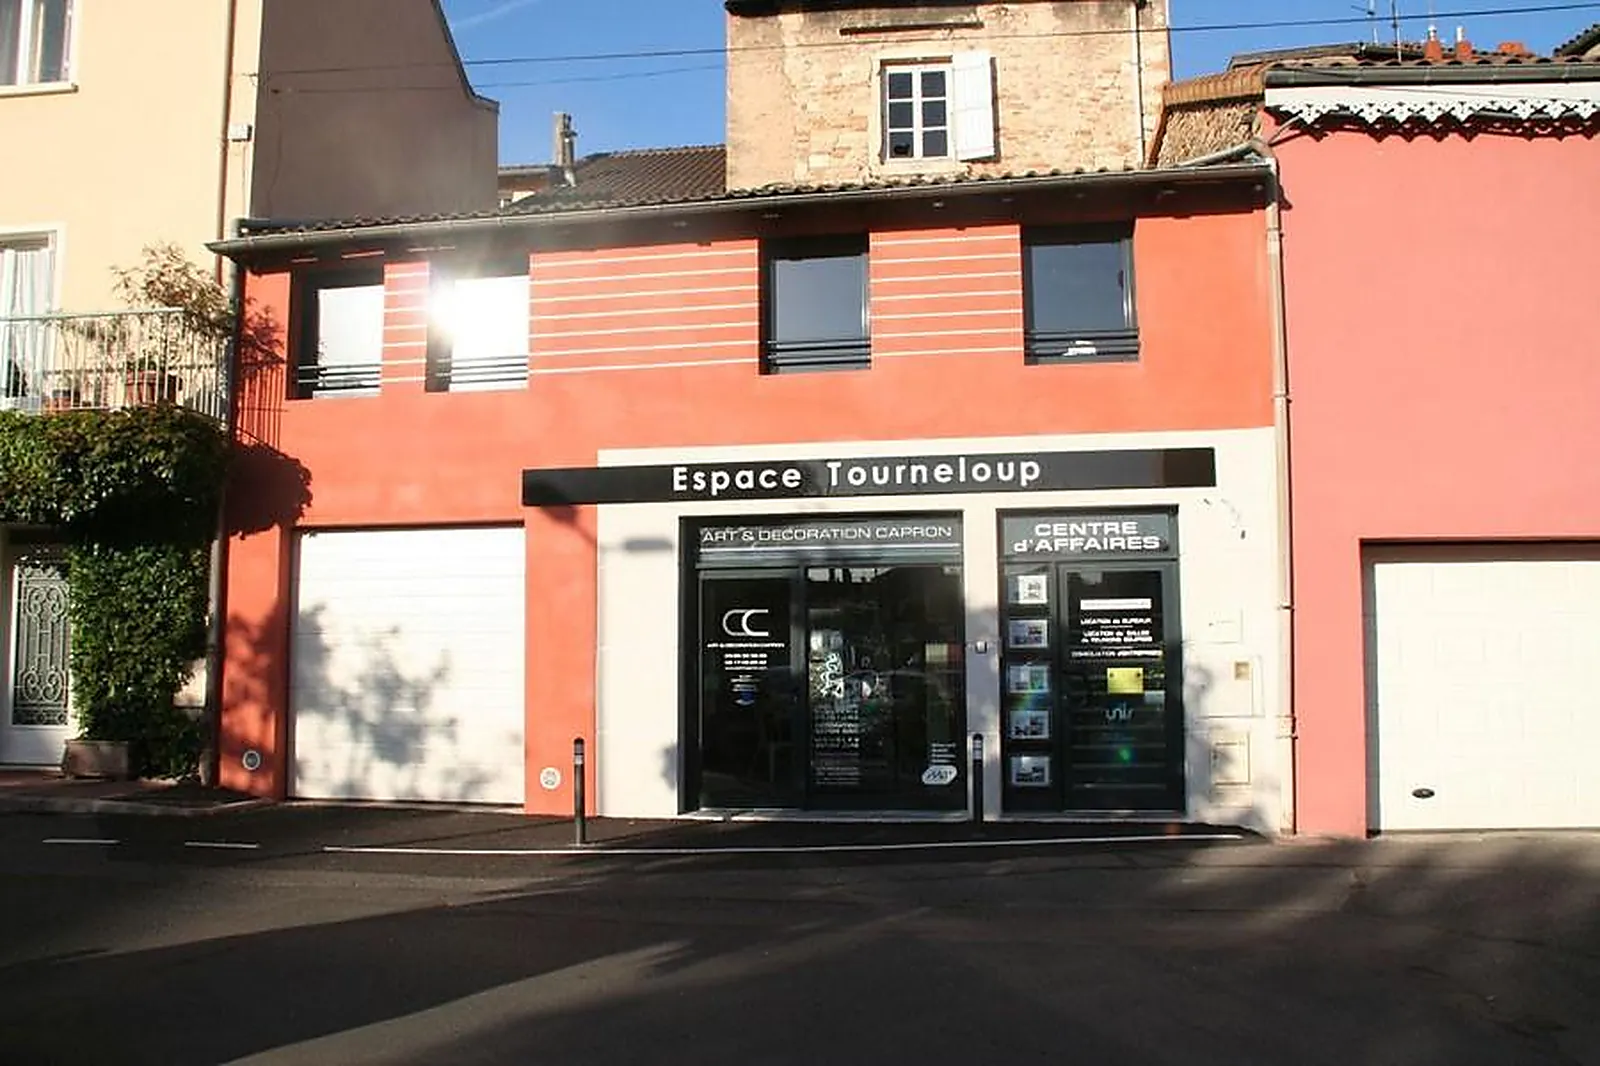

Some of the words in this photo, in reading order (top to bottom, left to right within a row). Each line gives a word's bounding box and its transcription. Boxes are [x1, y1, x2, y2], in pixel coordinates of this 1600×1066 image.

[672, 466, 802, 496] Espace
[826, 457, 1041, 487] Tourneloup
[702, 529, 738, 542] ART
[741, 529, 755, 542] &
[758, 526, 871, 542] DECORATION
[875, 525, 952, 539] CAPRON
[1034, 521, 1139, 537] CENTRE
[1013, 535, 1161, 552] d'AFFAIRES
